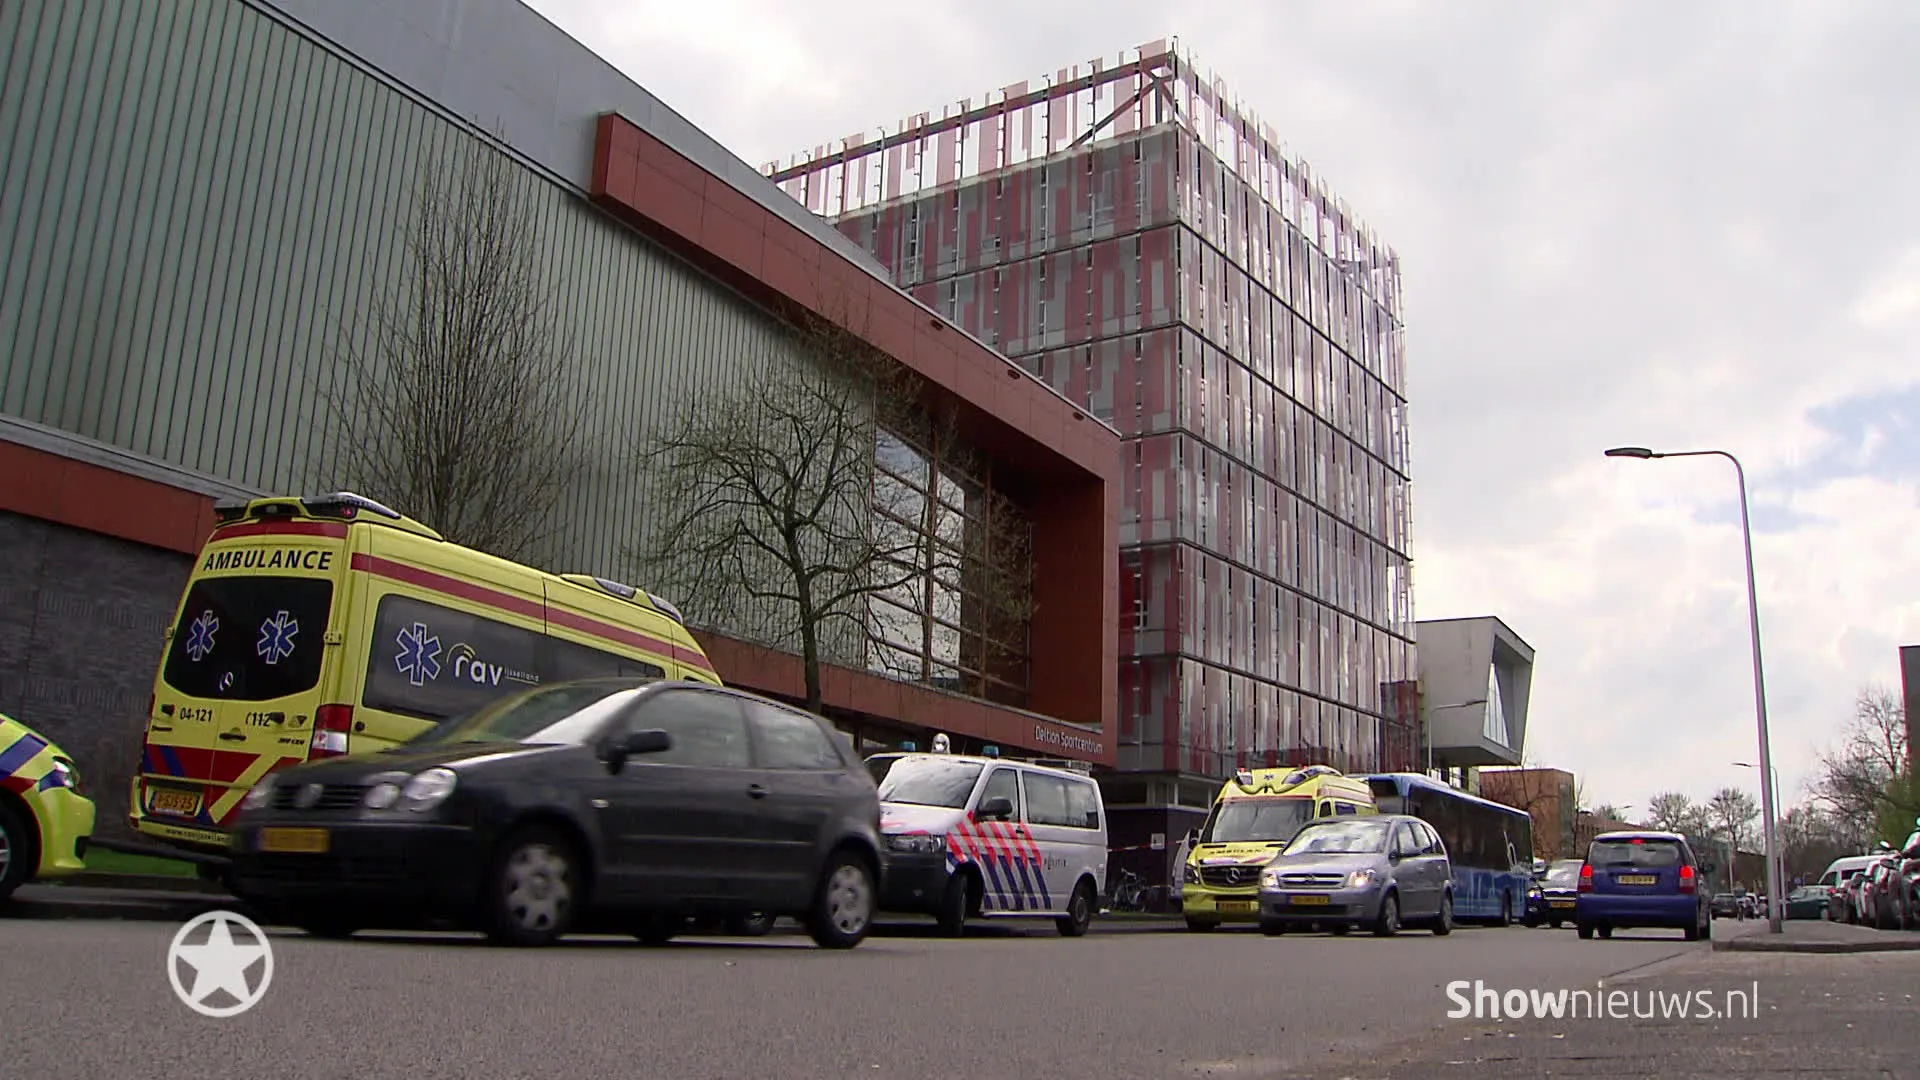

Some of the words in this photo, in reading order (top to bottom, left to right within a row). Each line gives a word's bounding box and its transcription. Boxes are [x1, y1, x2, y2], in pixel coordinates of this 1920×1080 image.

[203, 549, 333, 572] AMBULANCE
[454, 655, 503, 687] rav
[179, 707, 213, 722] 04-121
[1035, 725, 1060, 745] Deltion
[1060, 731, 1103, 754] Sportcentrum
